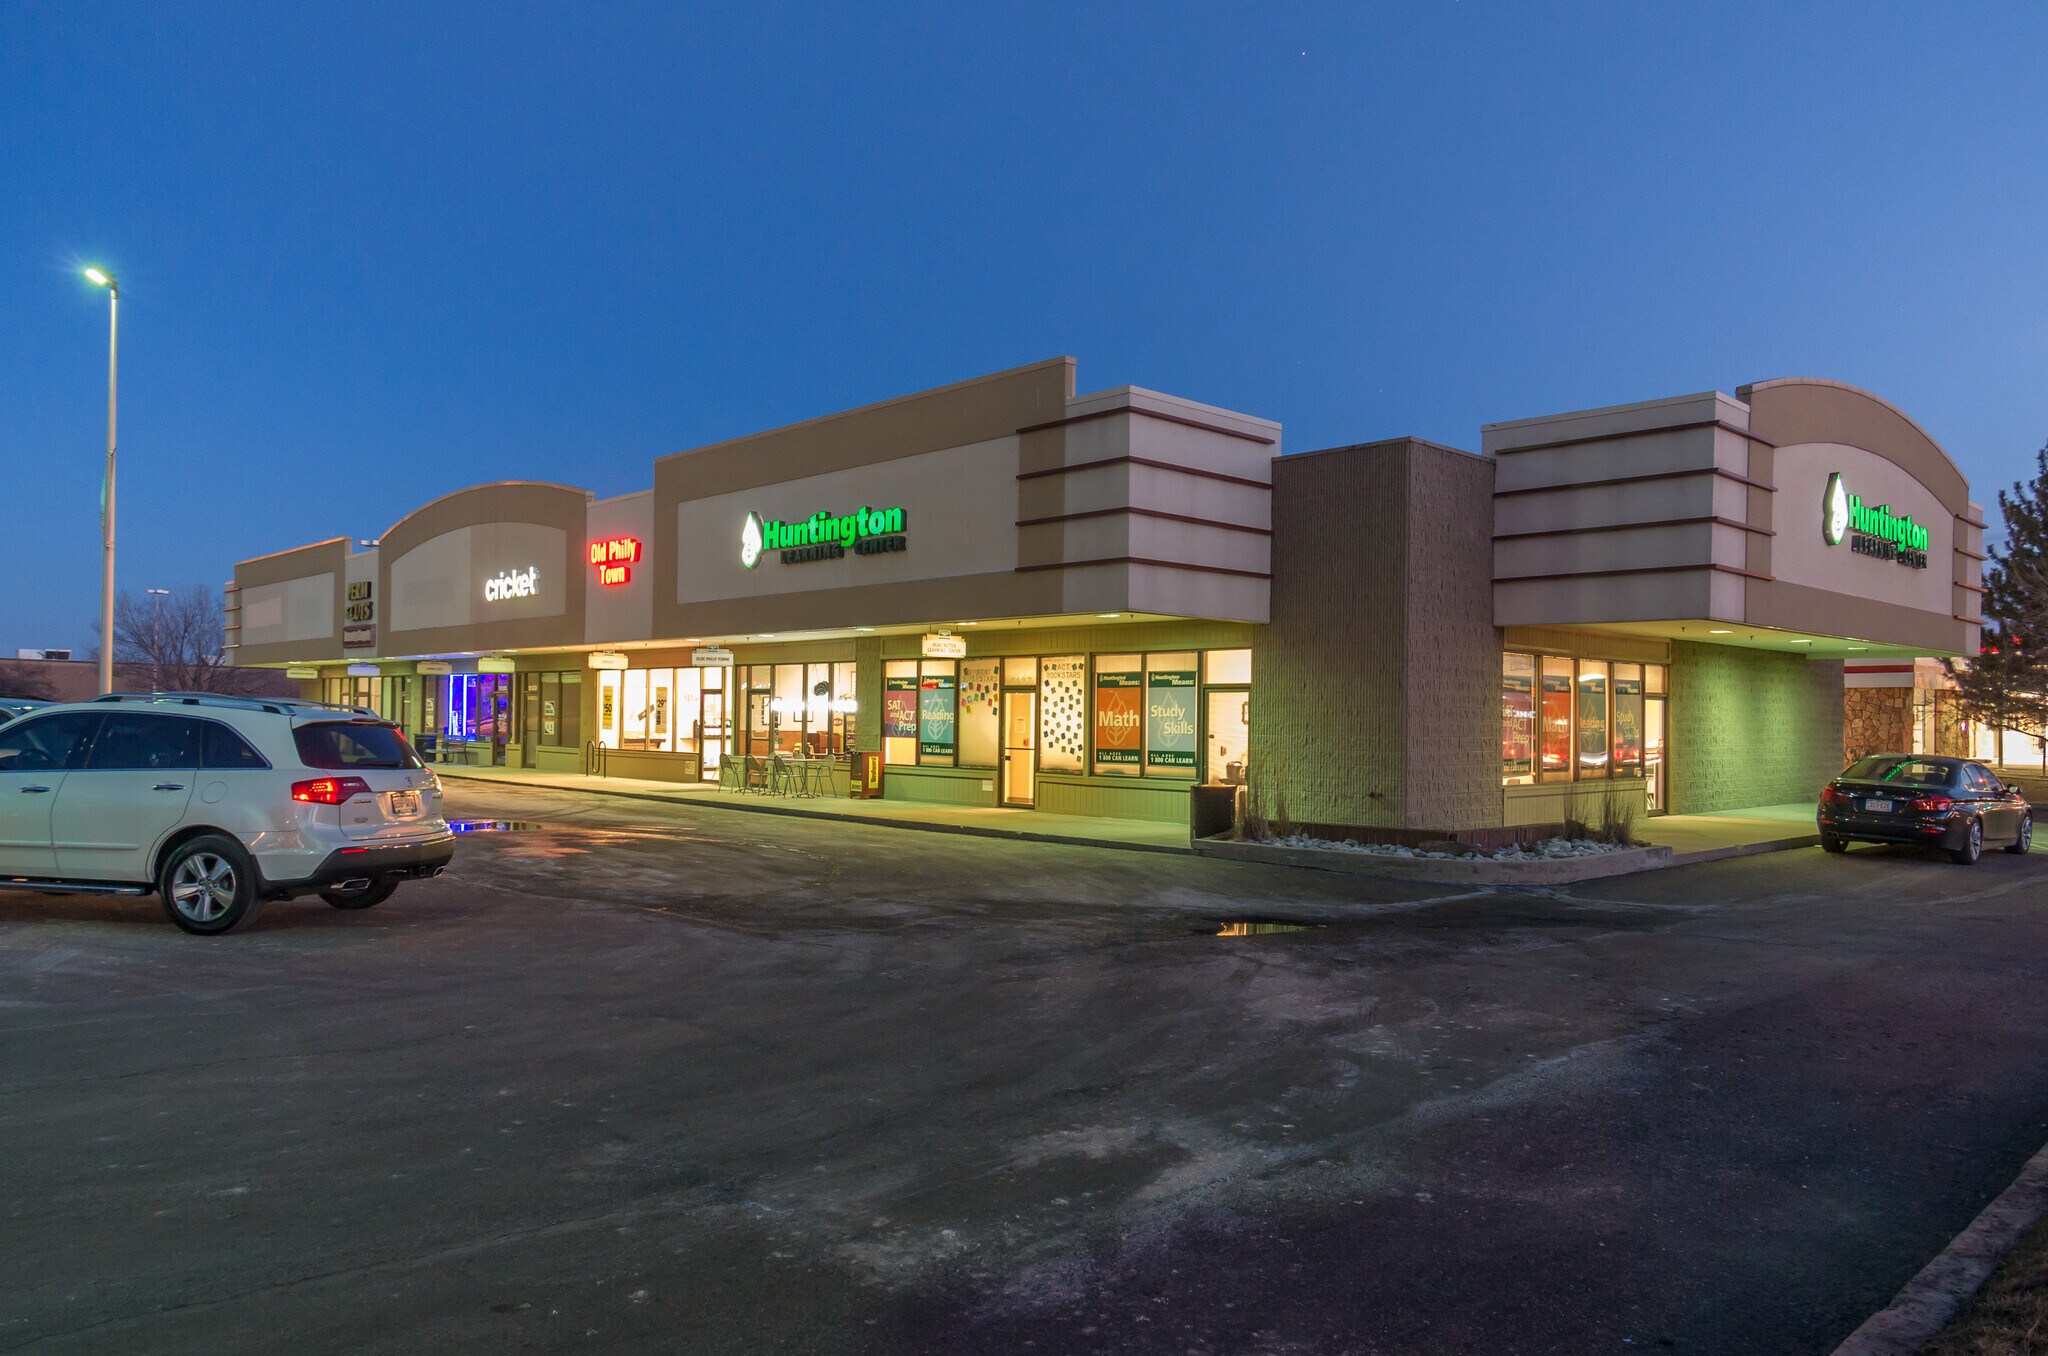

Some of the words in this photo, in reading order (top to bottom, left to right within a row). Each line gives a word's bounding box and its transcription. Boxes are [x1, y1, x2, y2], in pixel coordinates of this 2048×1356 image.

[763, 505, 903, 548] Huntington
[1848, 493, 1929, 552] Huntington
[591, 543, 607, 563] Old
[609, 538, 637, 562] Philly
[780, 544, 845, 565] LEARNING
[853, 536, 907, 557] CENTER
[485, 566, 537, 601] cricket
[600, 566, 626, 584] Town
[887, 700, 901, 710] SAT
[1151, 704, 1186, 721] Study
[899, 710, 915, 720] ACT
[922, 708, 954, 723] Reading
[1099, 710, 1140, 727] Math
[899, 720, 917, 733] Prep
[1164, 721, 1194, 735] Skills
[1512, 718, 1528, 731] ACT
